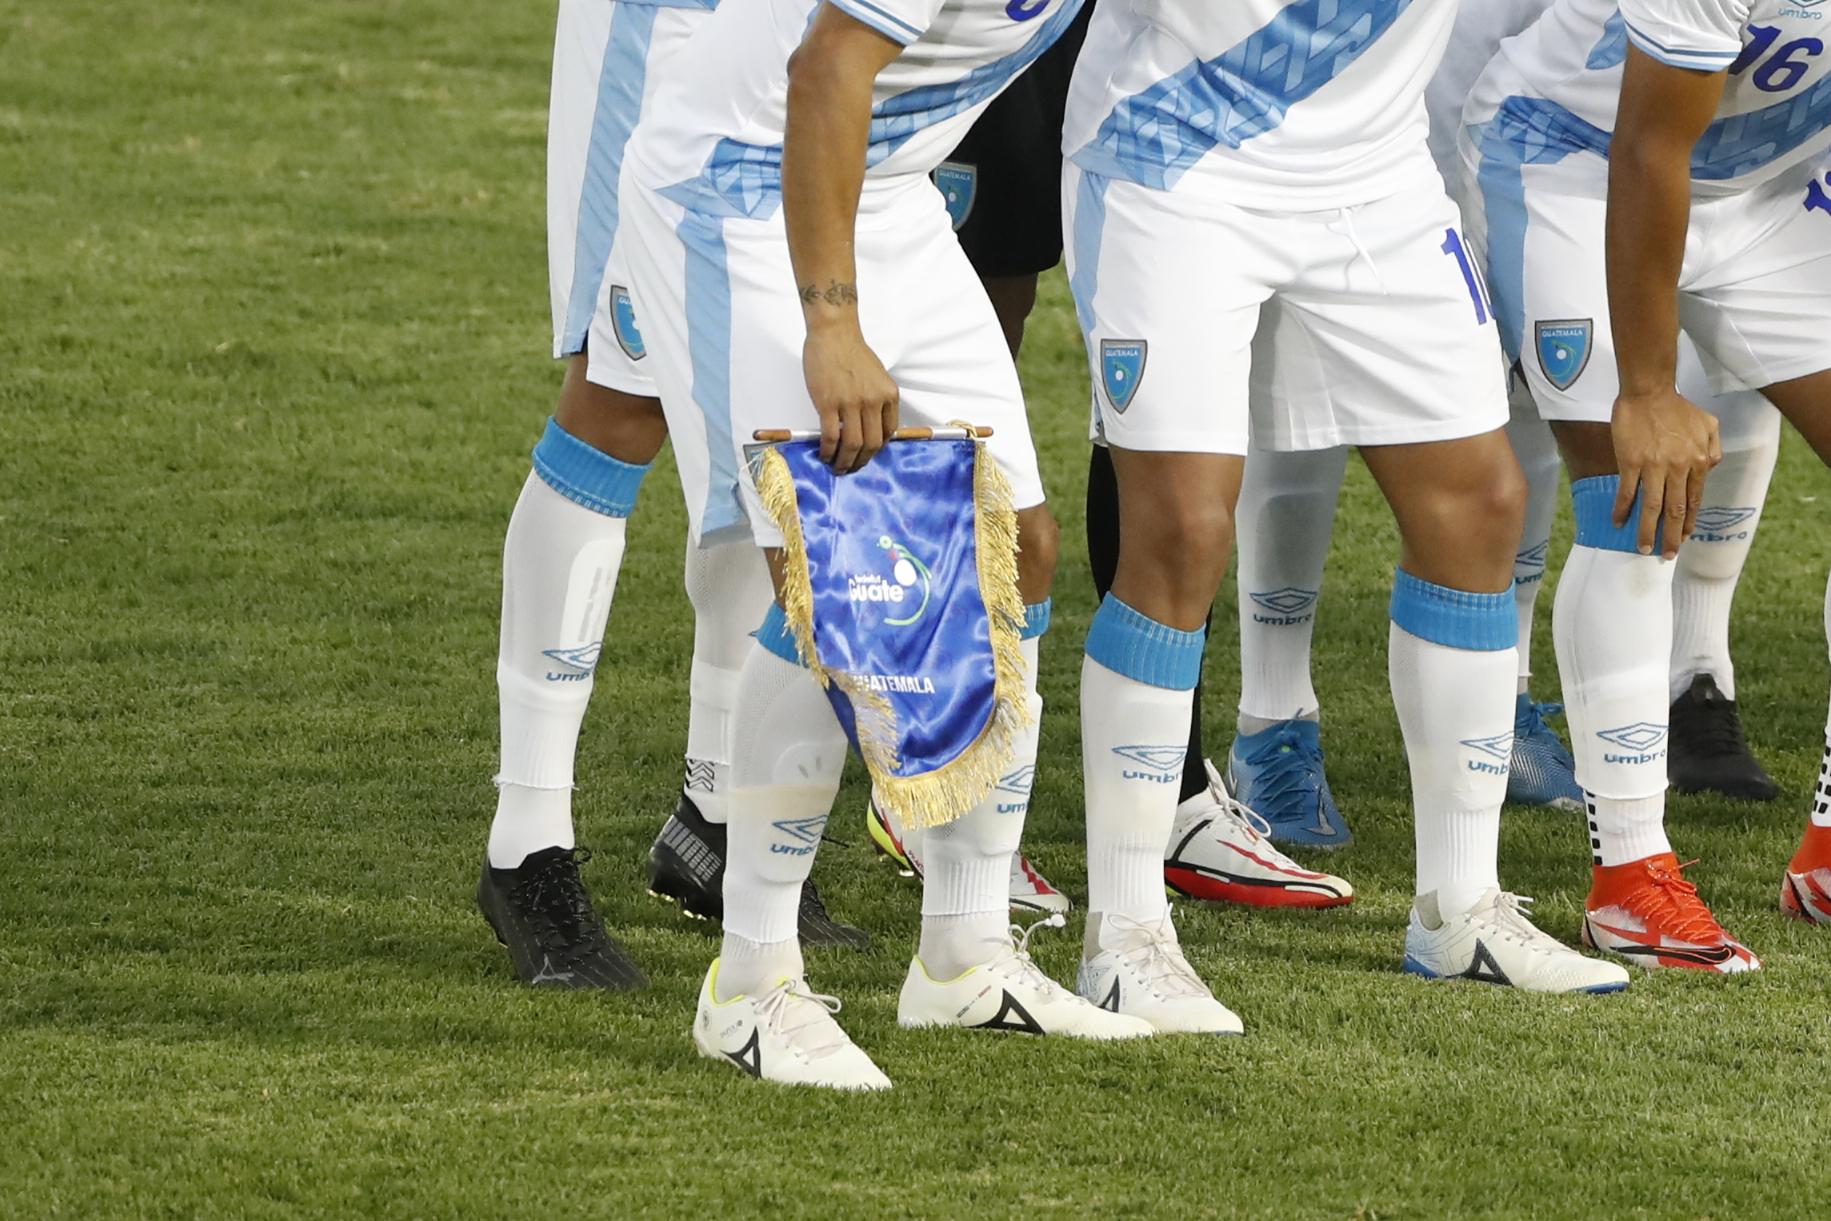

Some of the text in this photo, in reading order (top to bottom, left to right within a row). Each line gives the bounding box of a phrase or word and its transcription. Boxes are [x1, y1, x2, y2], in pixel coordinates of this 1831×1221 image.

[1778, 7, 1823, 20] umbro
[1727, 23, 1824, 92] 16
[1440, 227, 1496, 326] 1
[1541, 329, 1584, 338] GUATEMALA
[1105, 349, 1139, 357] GUATEMALA
[1690, 531, 1748, 542] mbro
[848, 578, 904, 602] Guate
[546, 671, 590, 682] umb
[1604, 748, 1666, 765] umbro
[1468, 760, 1509, 775] umb
[1123, 770, 1181, 784] umbr
[770, 843, 817, 856] umb
